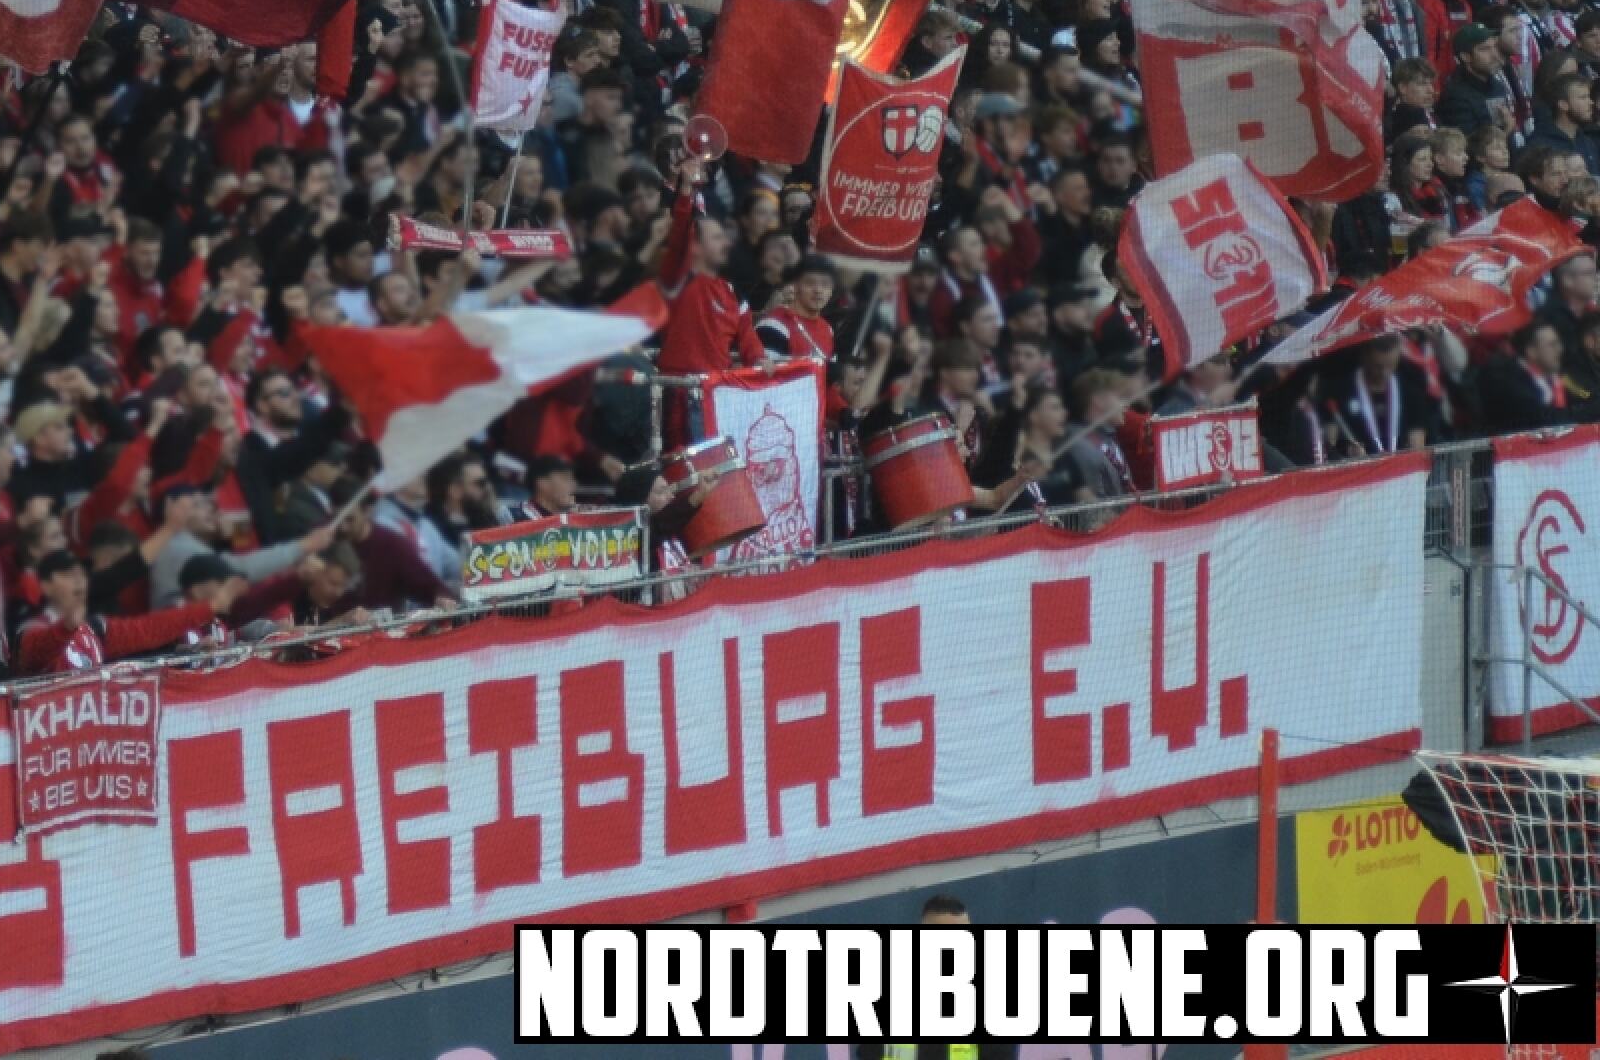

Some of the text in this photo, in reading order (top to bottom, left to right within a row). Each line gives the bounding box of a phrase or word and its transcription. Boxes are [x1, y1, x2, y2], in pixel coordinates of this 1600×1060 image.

[23, 691, 150, 744] KHALID
[24, 739, 151, 783] FÜR IMMER
[165, 605, 936, 959] FREIBURG
[1029, 551, 1250, 787] E.V.
[83, 772, 133, 801] UNS
[1355, 805, 1420, 851] LOTTO
